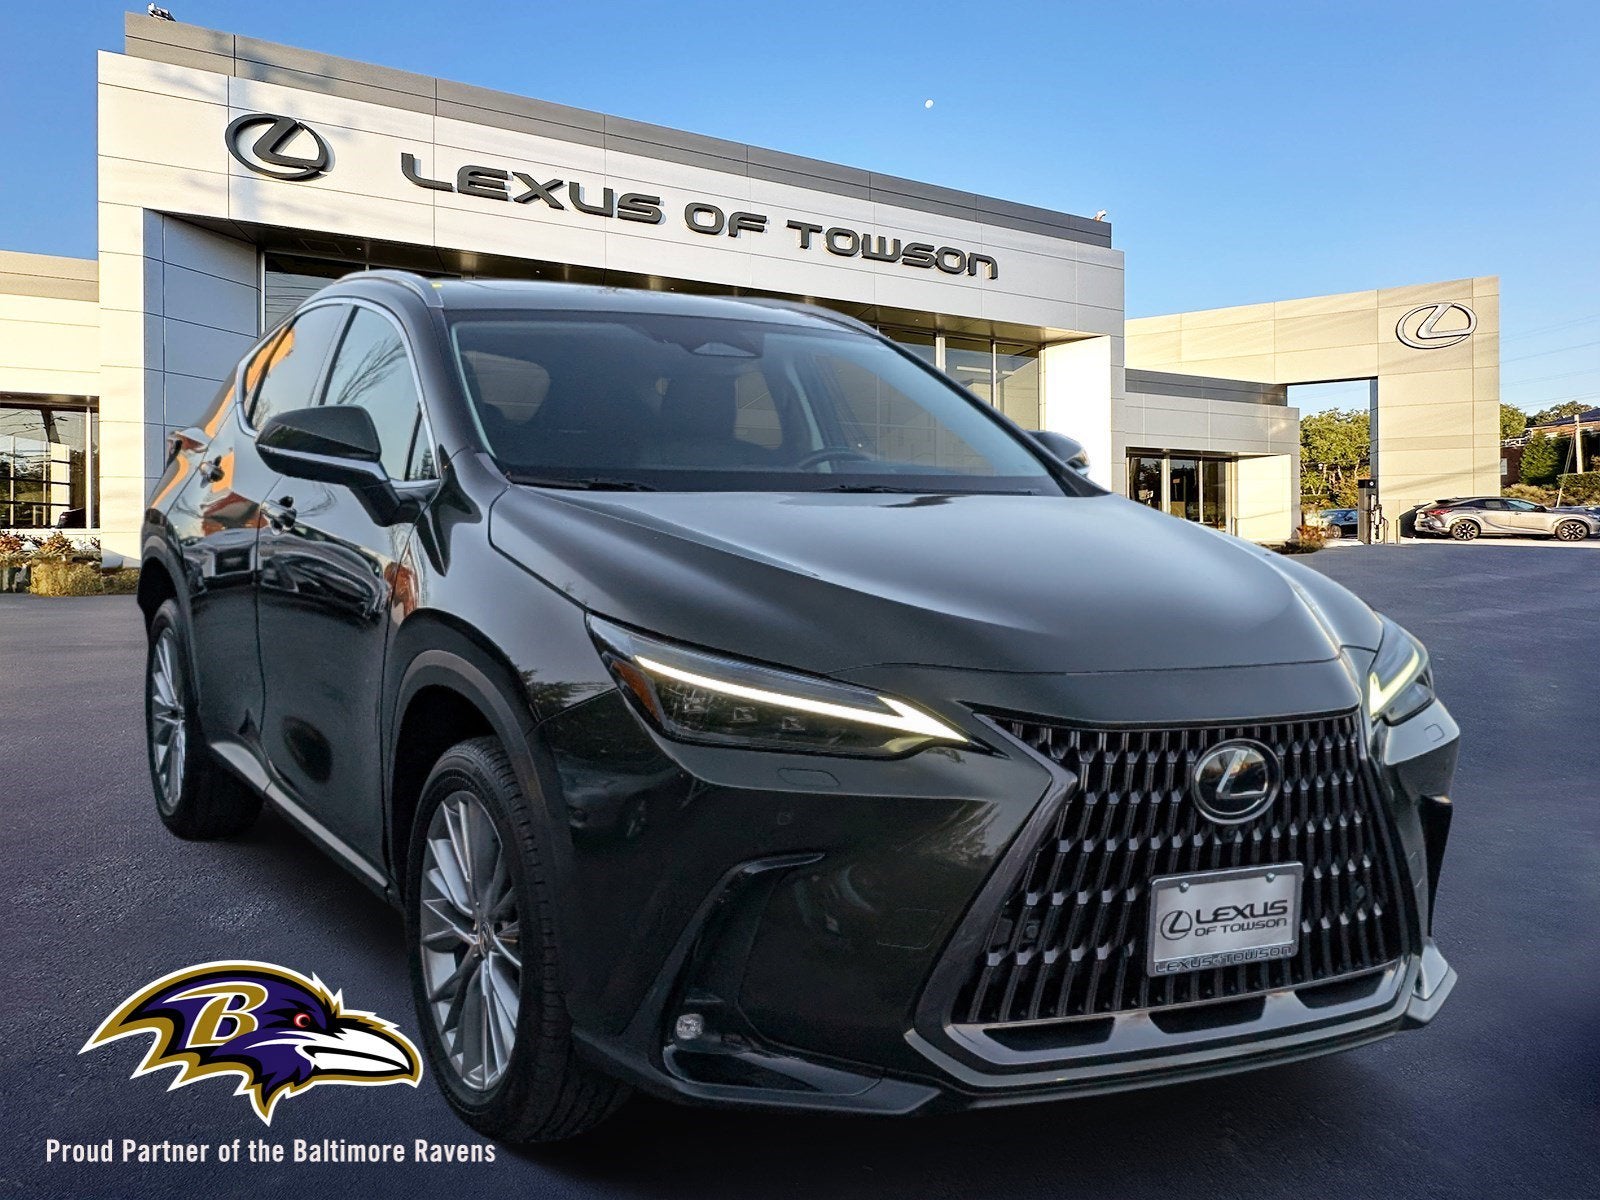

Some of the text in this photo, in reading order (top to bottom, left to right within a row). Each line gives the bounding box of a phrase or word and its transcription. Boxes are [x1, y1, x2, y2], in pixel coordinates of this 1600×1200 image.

[401, 152, 999, 280] LEXUS OF TOWSON
[1196, 900, 1288, 924] LEXUS
[1195, 917, 1288, 937] OF TOWSON
[1155, 957, 1212, 973] LEXUS
